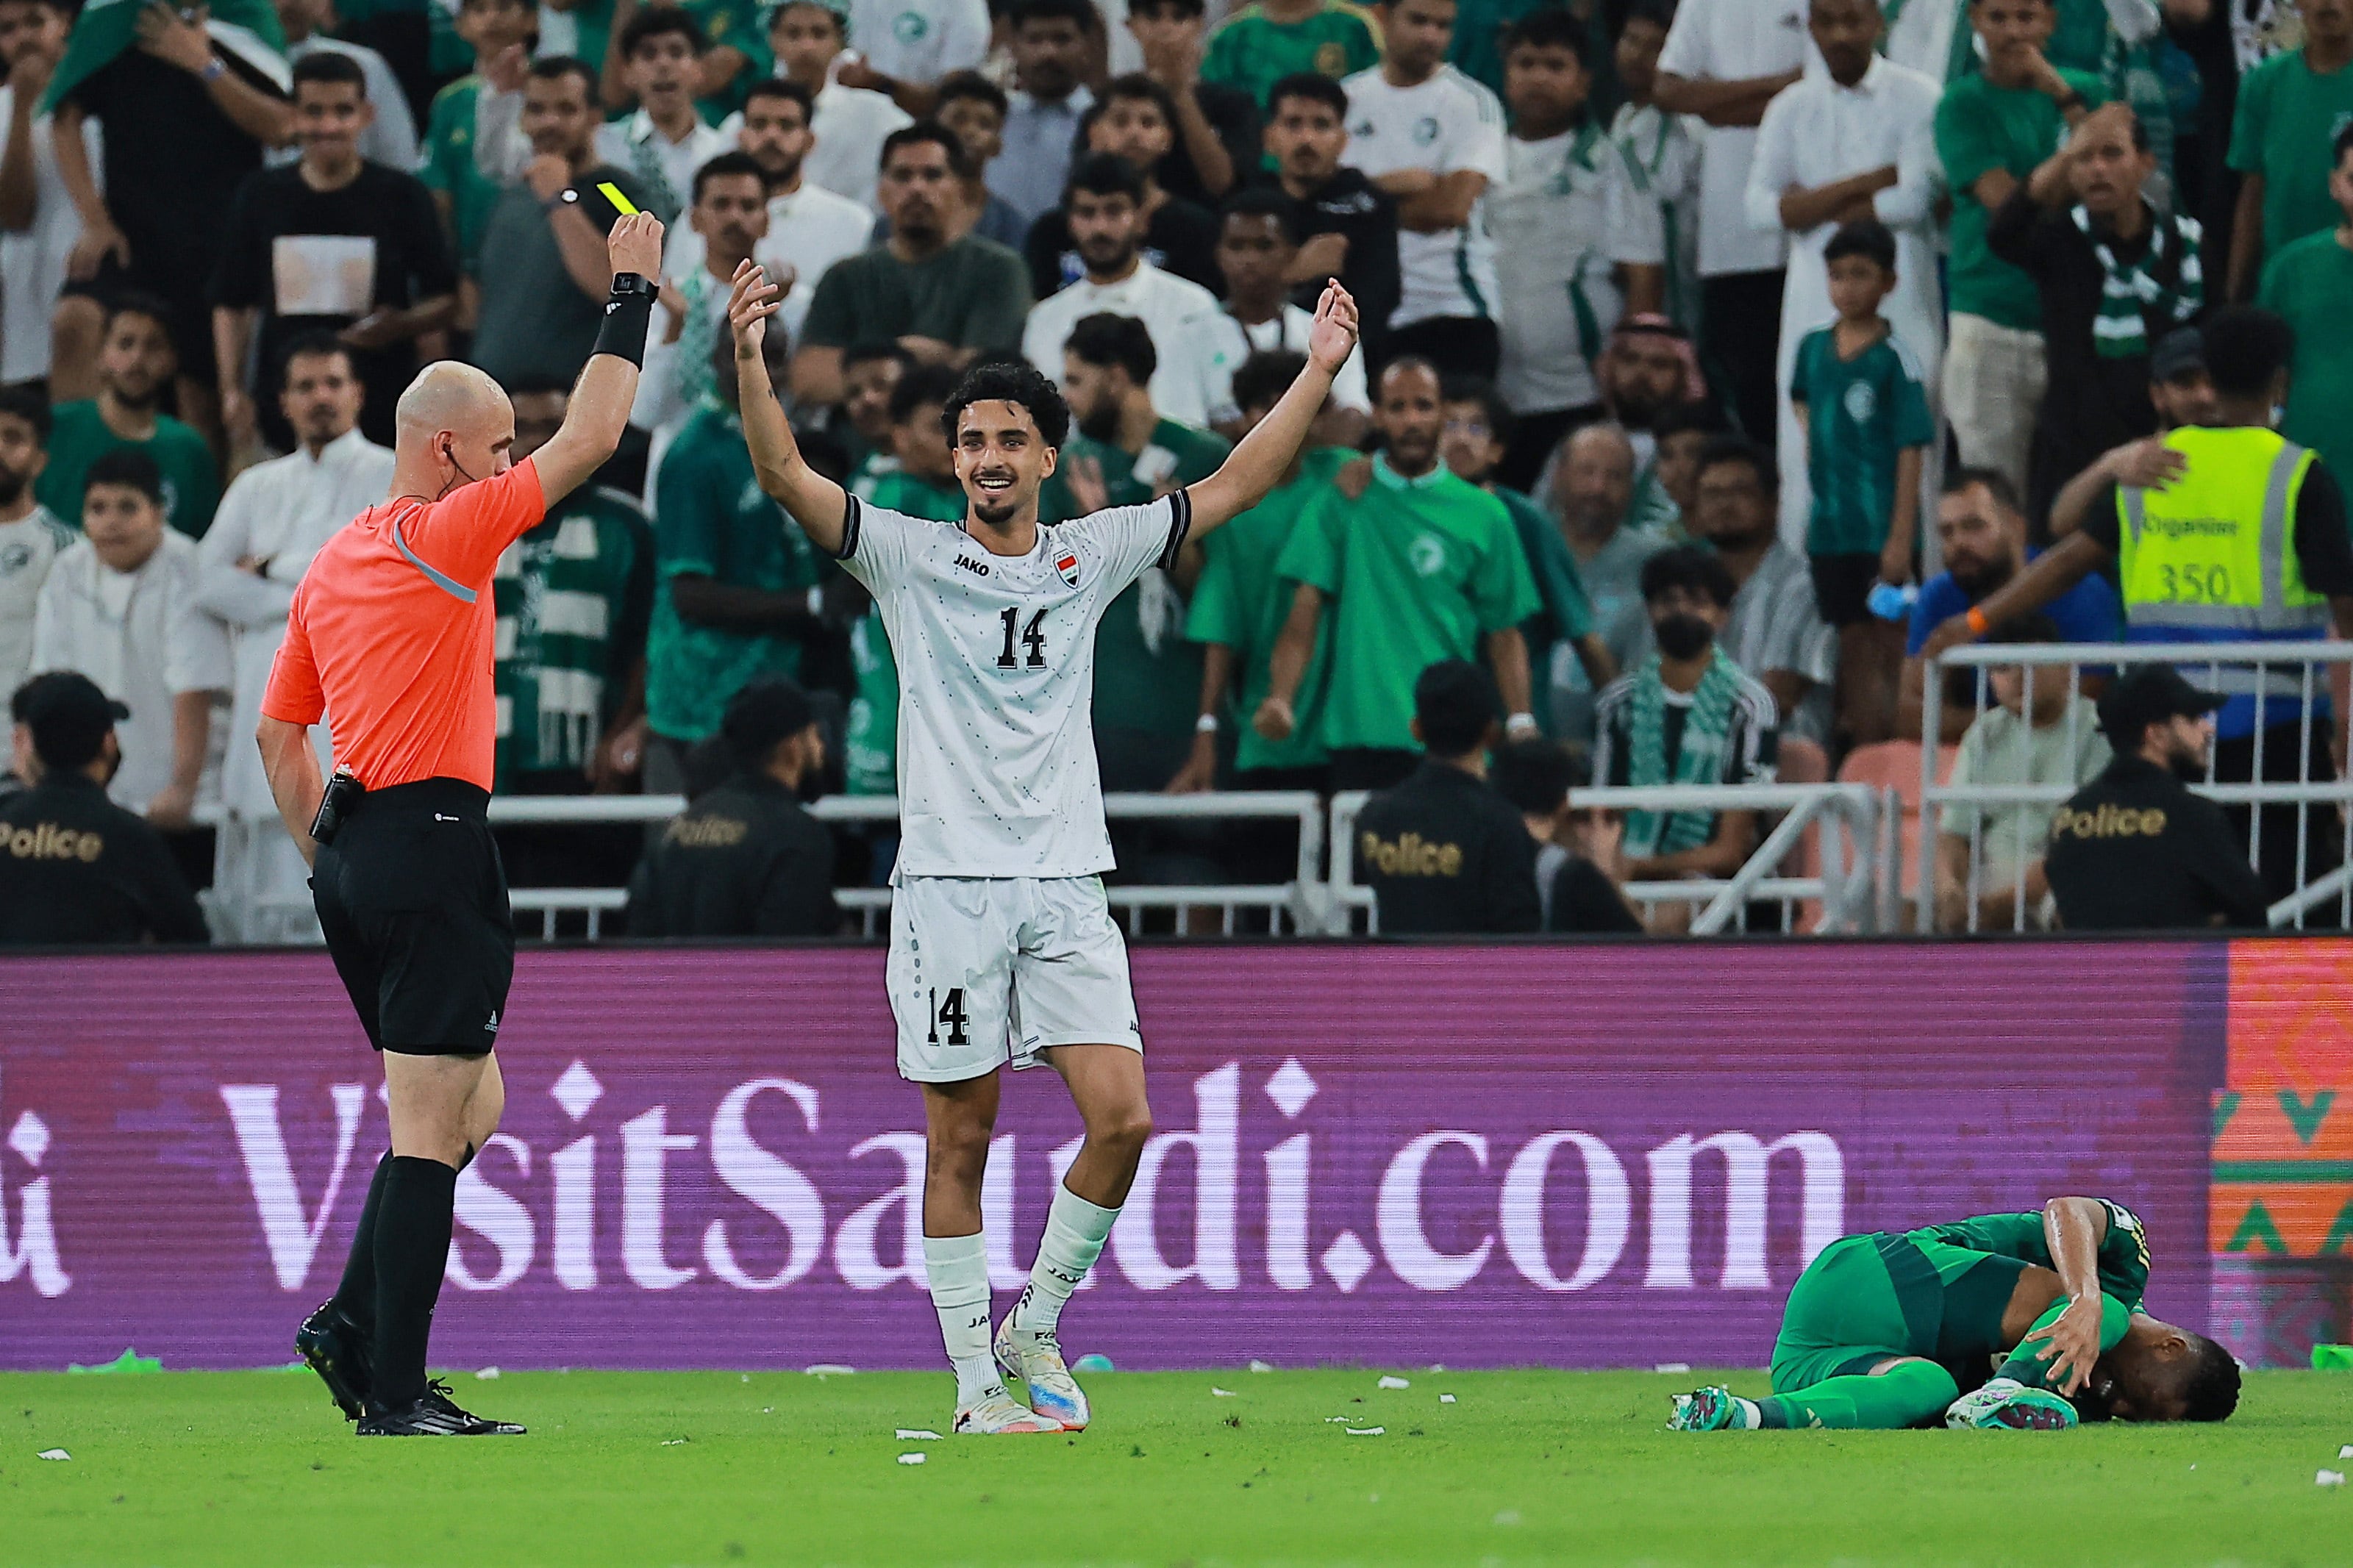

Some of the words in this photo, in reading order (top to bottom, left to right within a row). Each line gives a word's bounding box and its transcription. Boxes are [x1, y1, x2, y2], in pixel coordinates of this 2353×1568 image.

[953, 554, 990, 577] JAKO
[2160, 564, 2230, 604] 350
[997, 606, 1049, 670] 14
[2052, 803, 2167, 839] Police
[1362, 831, 1463, 877] Police
[927, 986, 971, 1047] 14
[219, 1056, 1845, 1292] VsitSaudi.com
